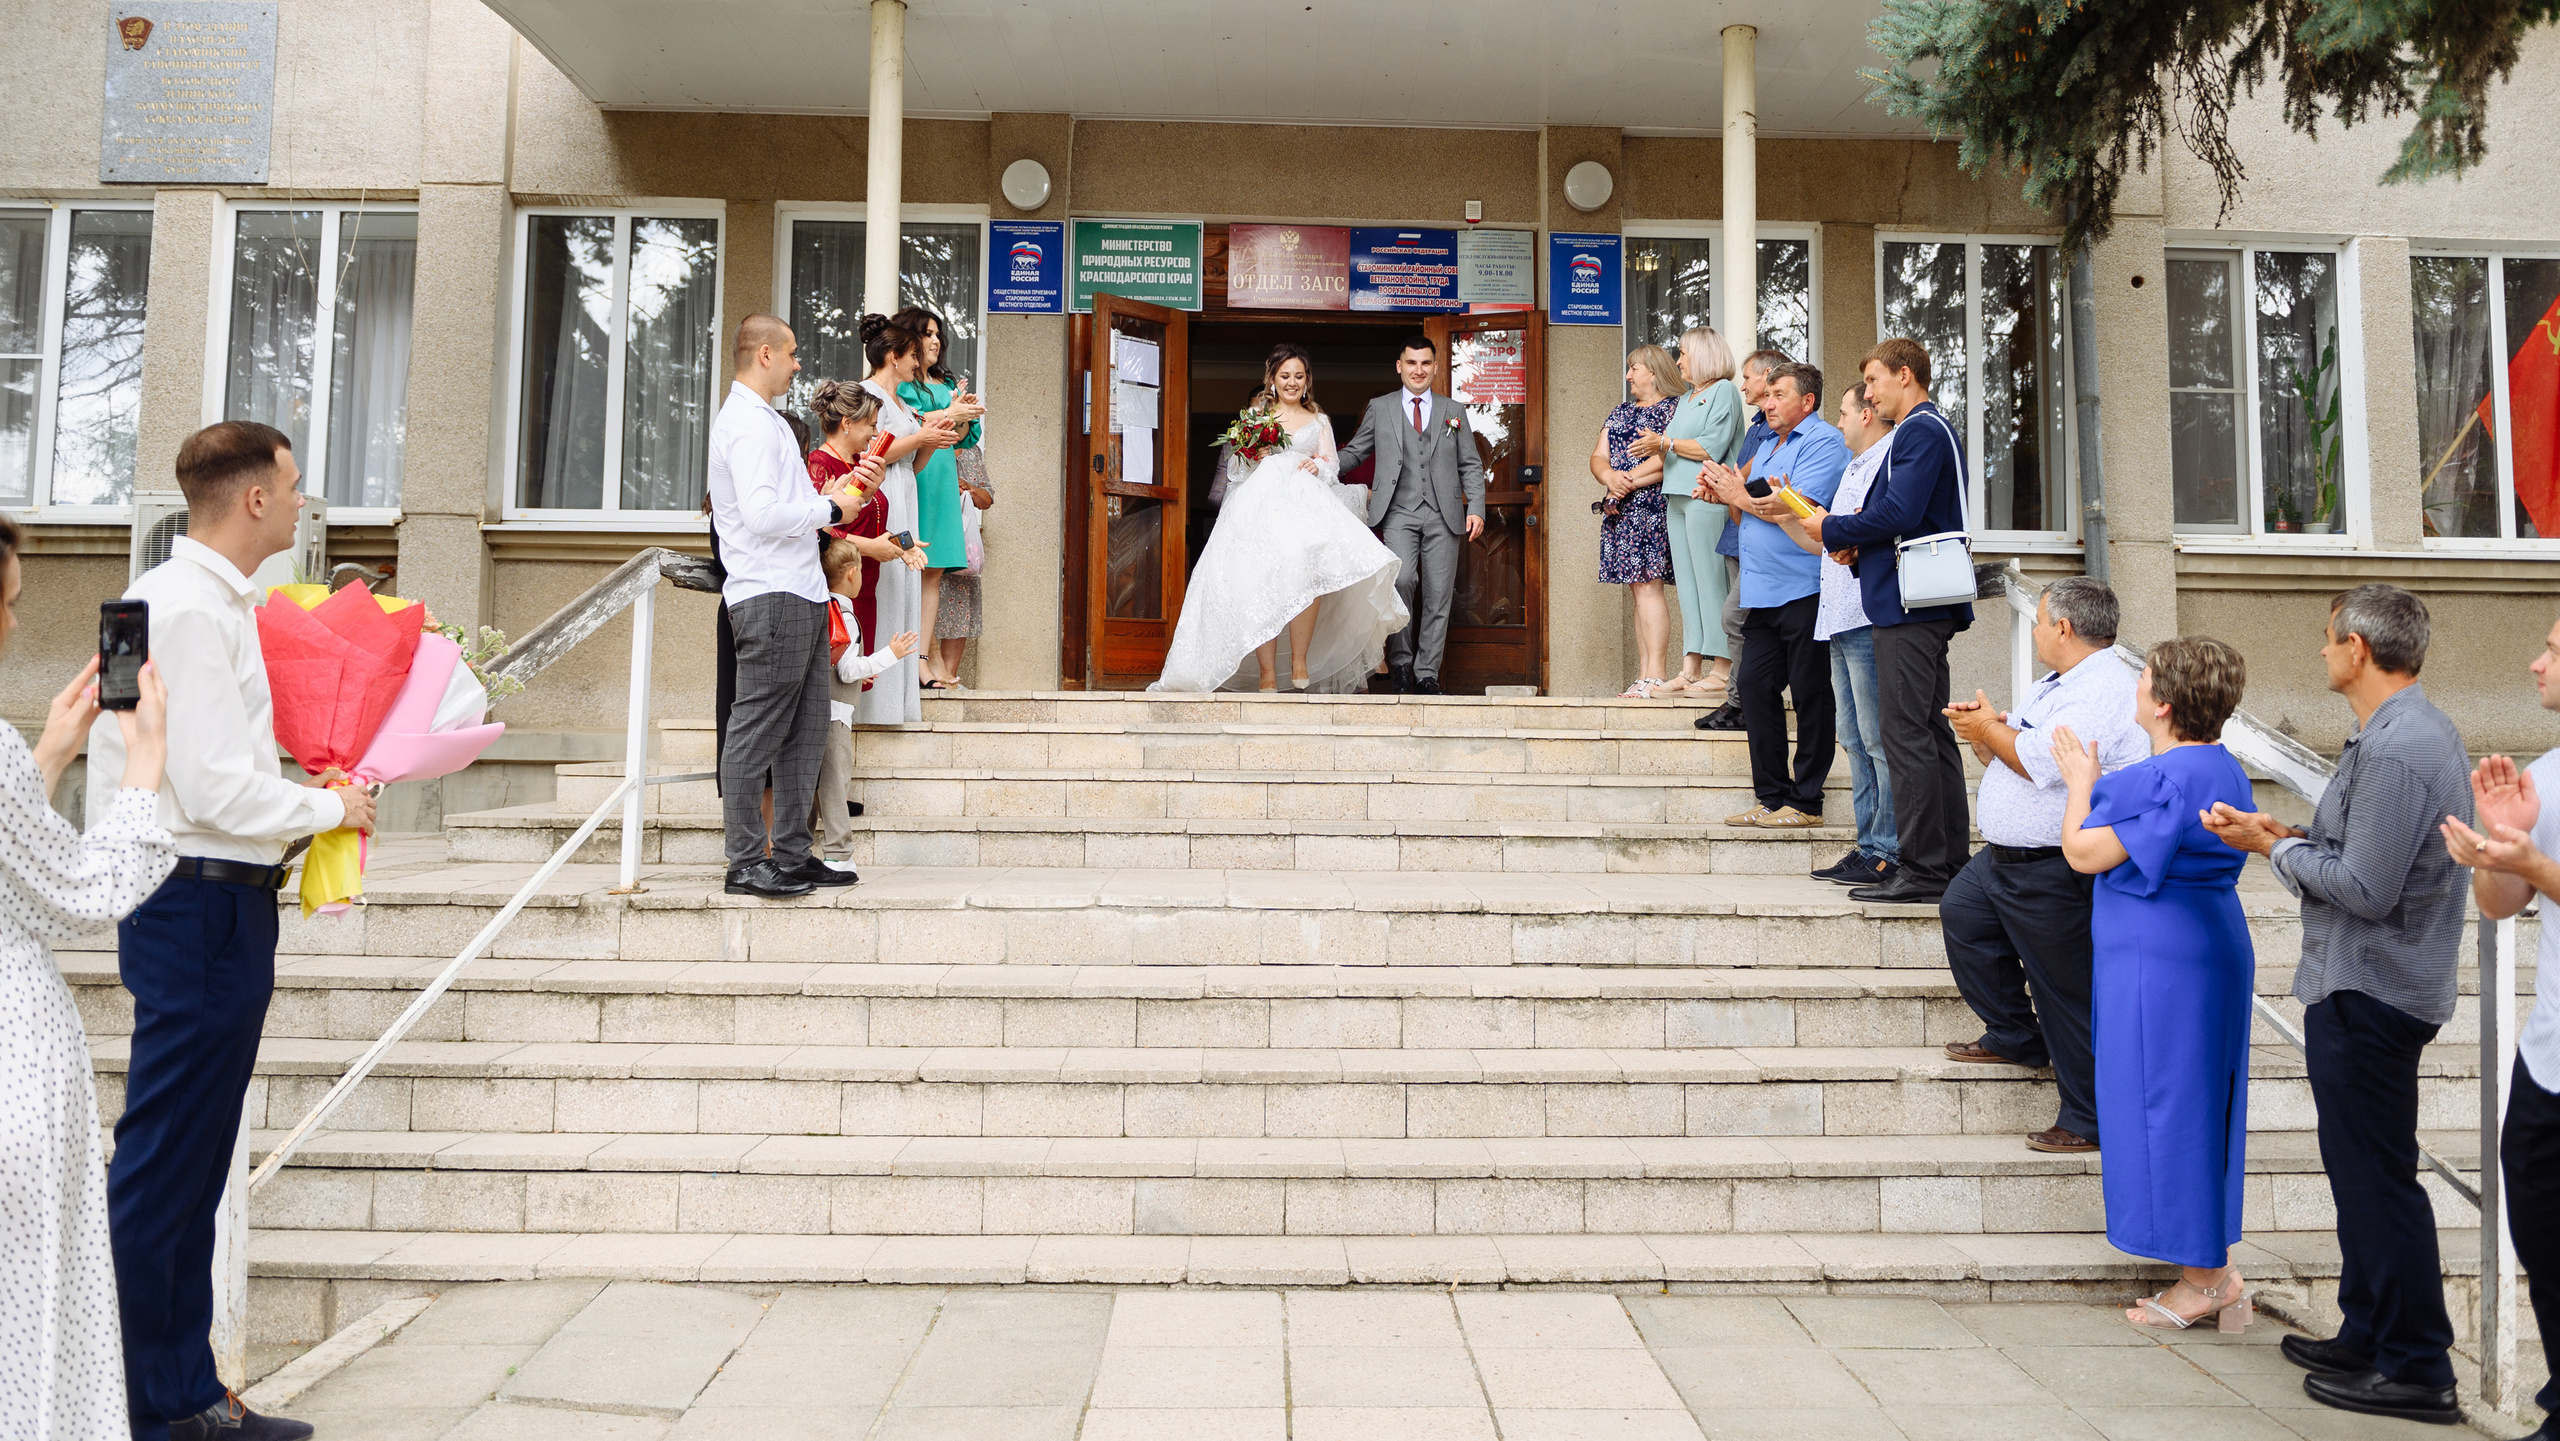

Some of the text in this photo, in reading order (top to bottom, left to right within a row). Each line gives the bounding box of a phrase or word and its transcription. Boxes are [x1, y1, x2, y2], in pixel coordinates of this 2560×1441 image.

[1101, 239, 1172, 252] МИНИСТЕРСТВО
[1371, 246, 1449, 255] РОССИЙСКАЯ ФЕДЕРАЦИЯ
[1082, 255, 1191, 268] ПРИРОДНЫХ РЕСУРСОВ
[1357, 263, 1458, 274] СТАРОМИНСКИЙ РАЙОННЫЙ СОВЕ
[1079, 271, 1192, 285] КРАСНОДАРСКОГО КРАЯ
[1234, 273, 1345, 293] ОТДЕЛ ЗАГС
[1370, 275, 1403, 283] ВЕТЕРАНОВ
[1429, 277, 1449, 286] ТРУДА
